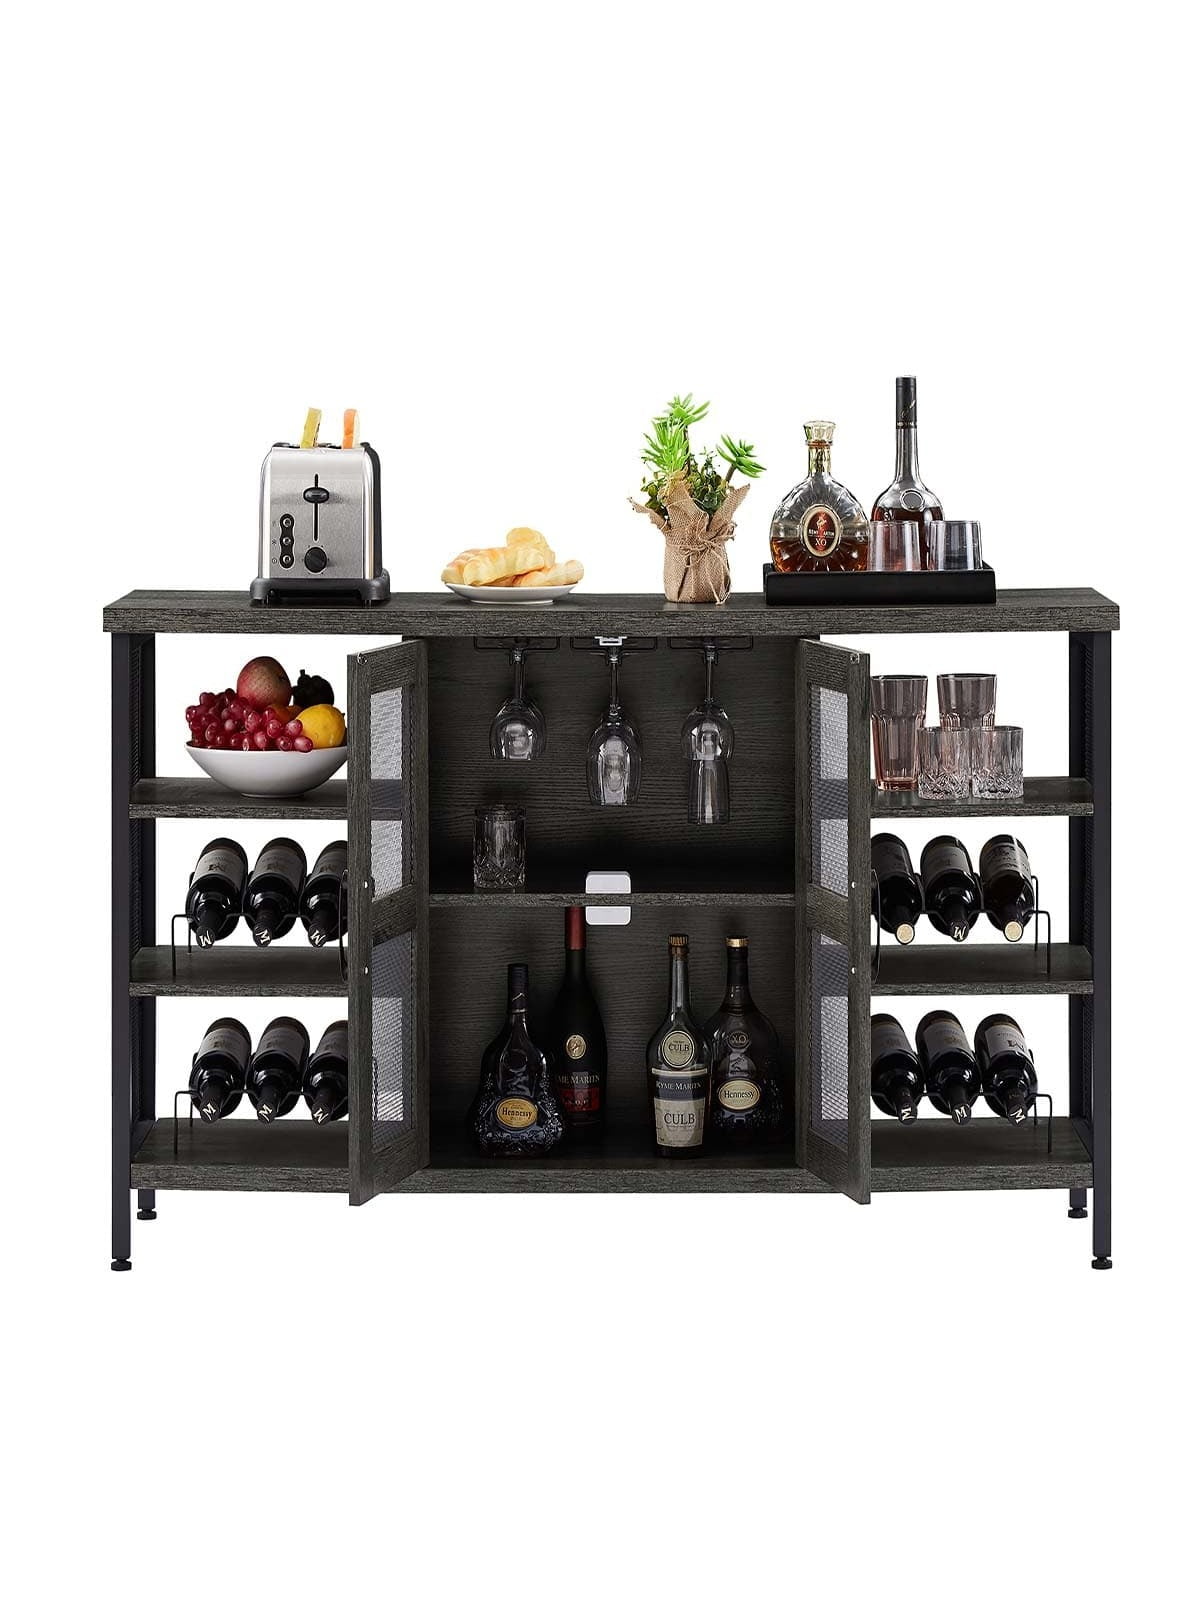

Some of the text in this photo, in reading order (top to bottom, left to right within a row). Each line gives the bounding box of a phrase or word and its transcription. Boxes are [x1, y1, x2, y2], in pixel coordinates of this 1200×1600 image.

[815, 537, 827, 546] XO
[723, 1090, 755, 1100] Hennessy
[502, 1107, 533, 1119] Hennessy
[663, 1112, 696, 1125] CULB
